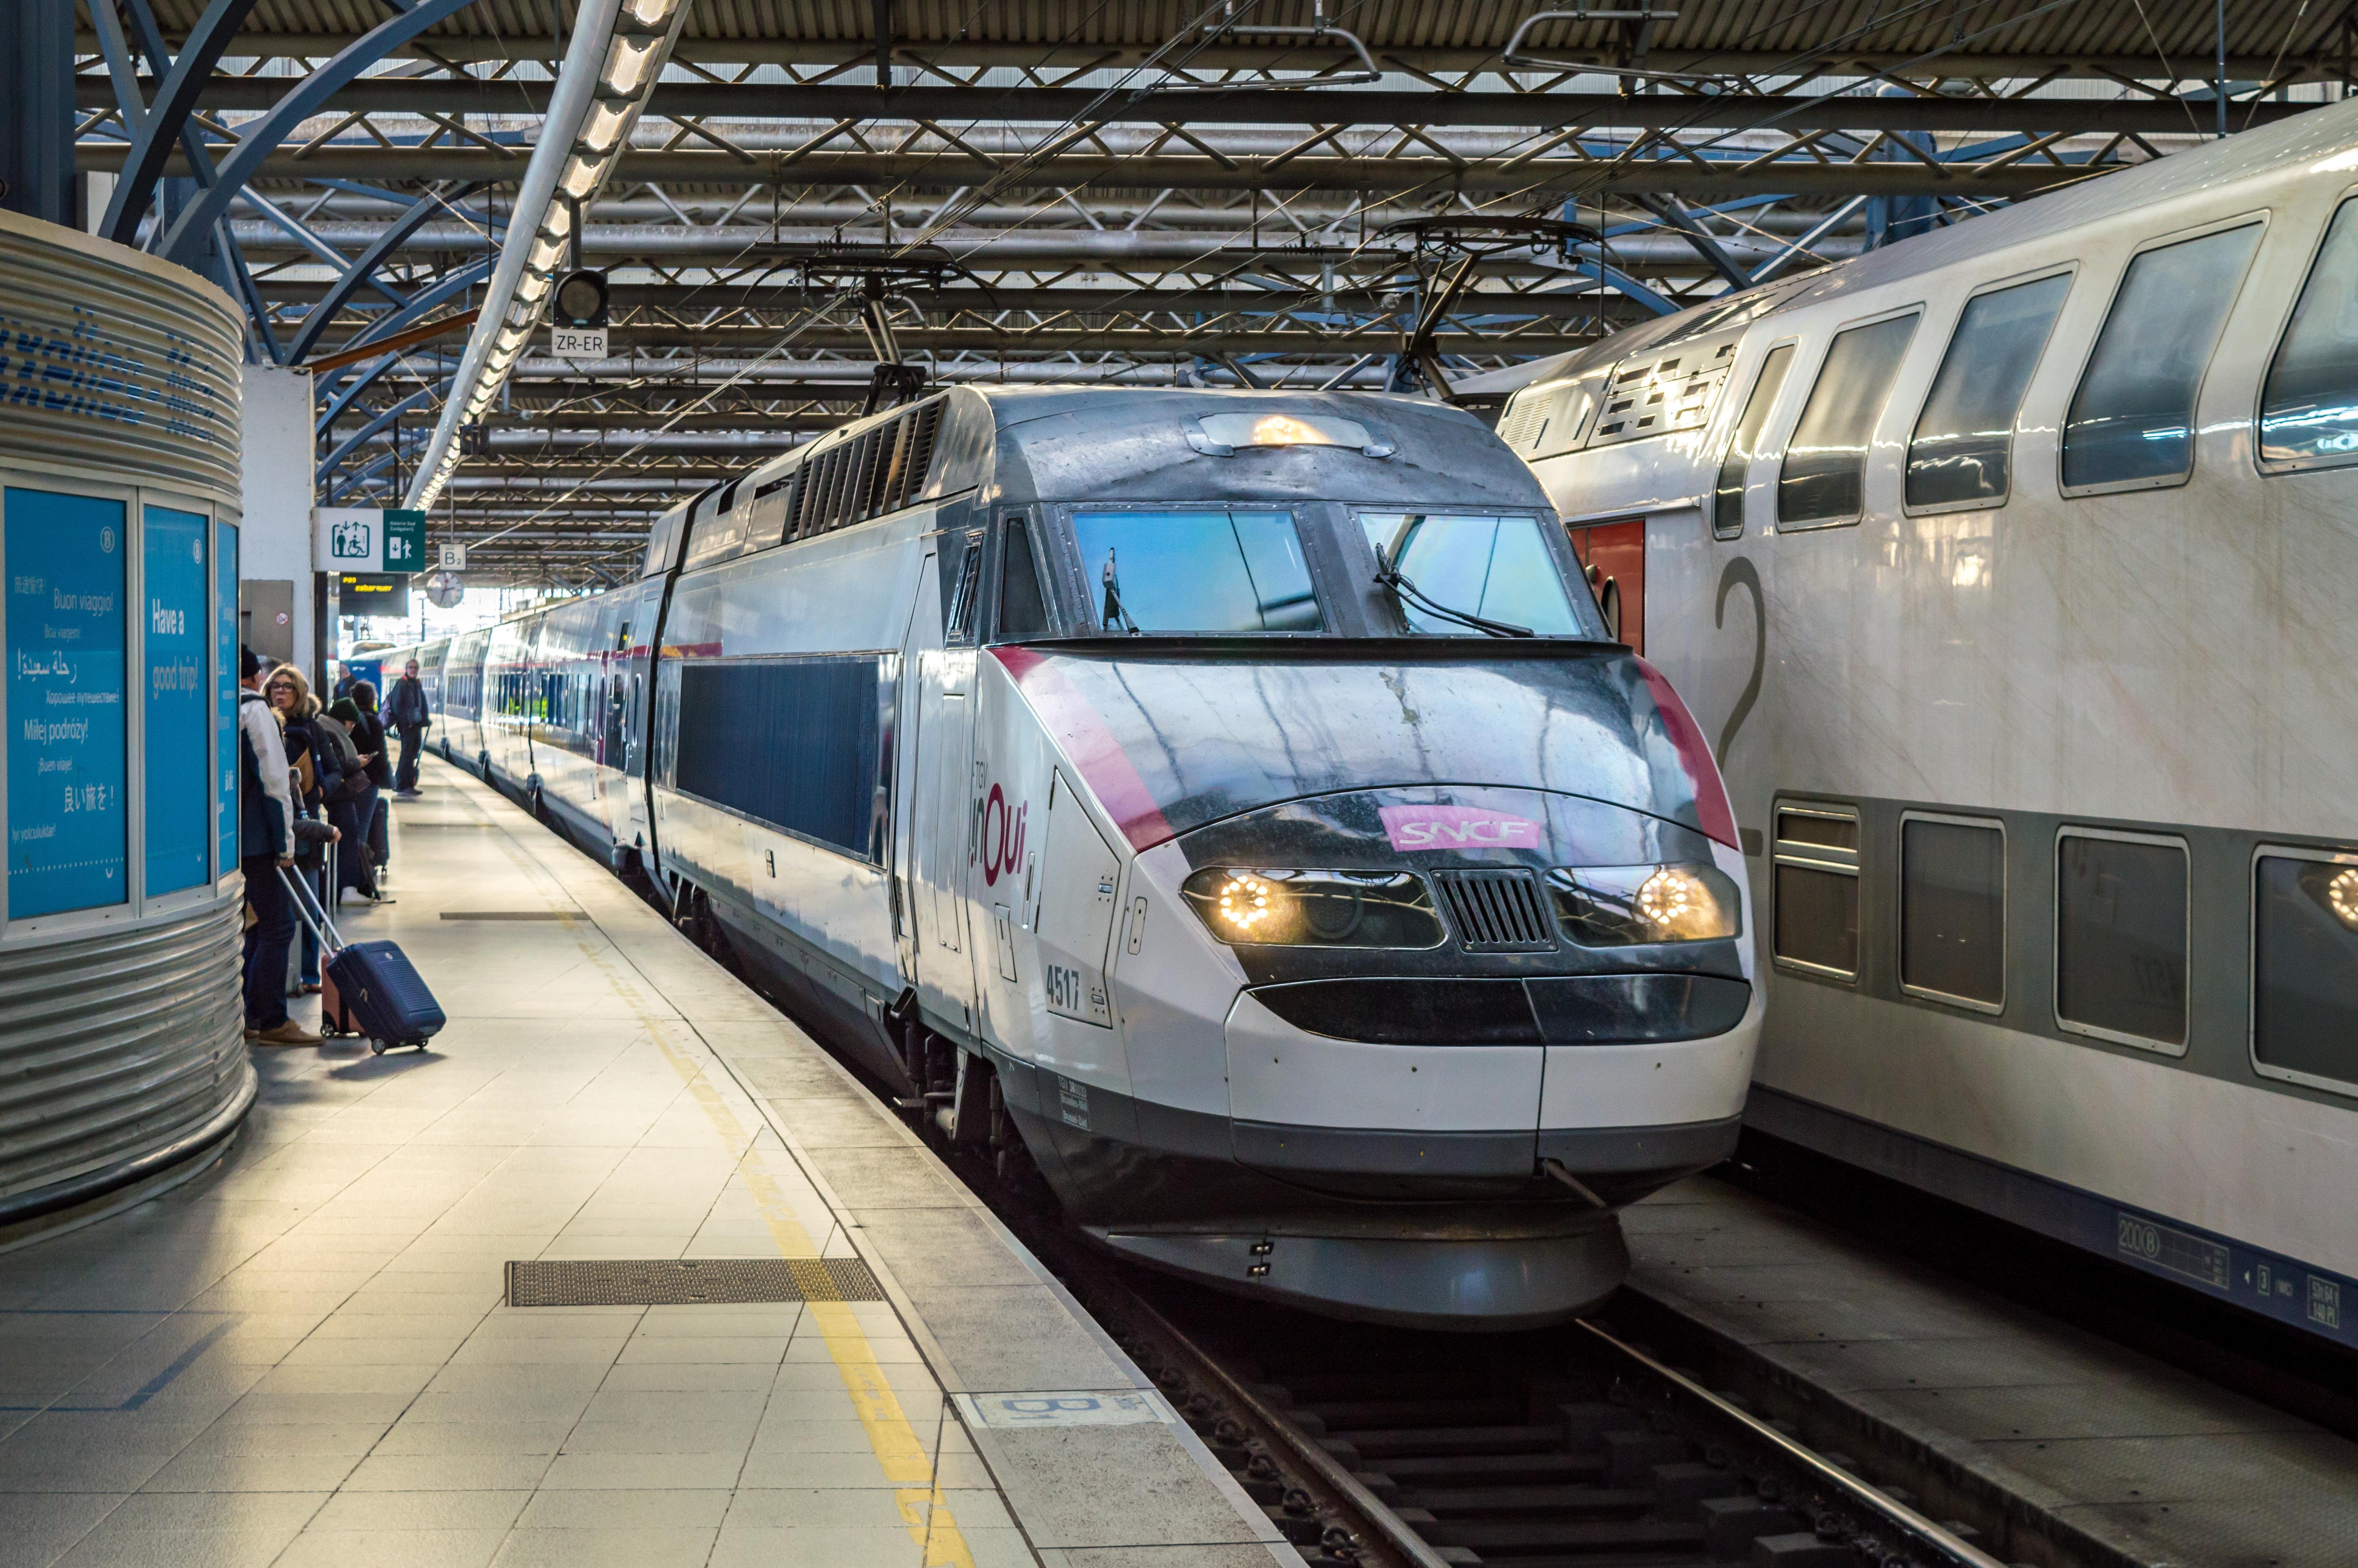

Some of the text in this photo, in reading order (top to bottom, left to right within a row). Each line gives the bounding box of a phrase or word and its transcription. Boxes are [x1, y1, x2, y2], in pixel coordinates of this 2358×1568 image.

[557, 335, 602, 351] ZR-ER
[54, 588, 113, 616] Buon viaggio!
[152, 598, 184, 634] Have a
[52, 649, 77, 683] رحلة
[152, 655, 198, 700] good trip!
[25, 717, 88, 746] Miłej podróży!
[975, 761, 988, 789] TGV
[1399, 820, 1529, 845] SNCF
[1046, 964, 1079, 1011] 4517
